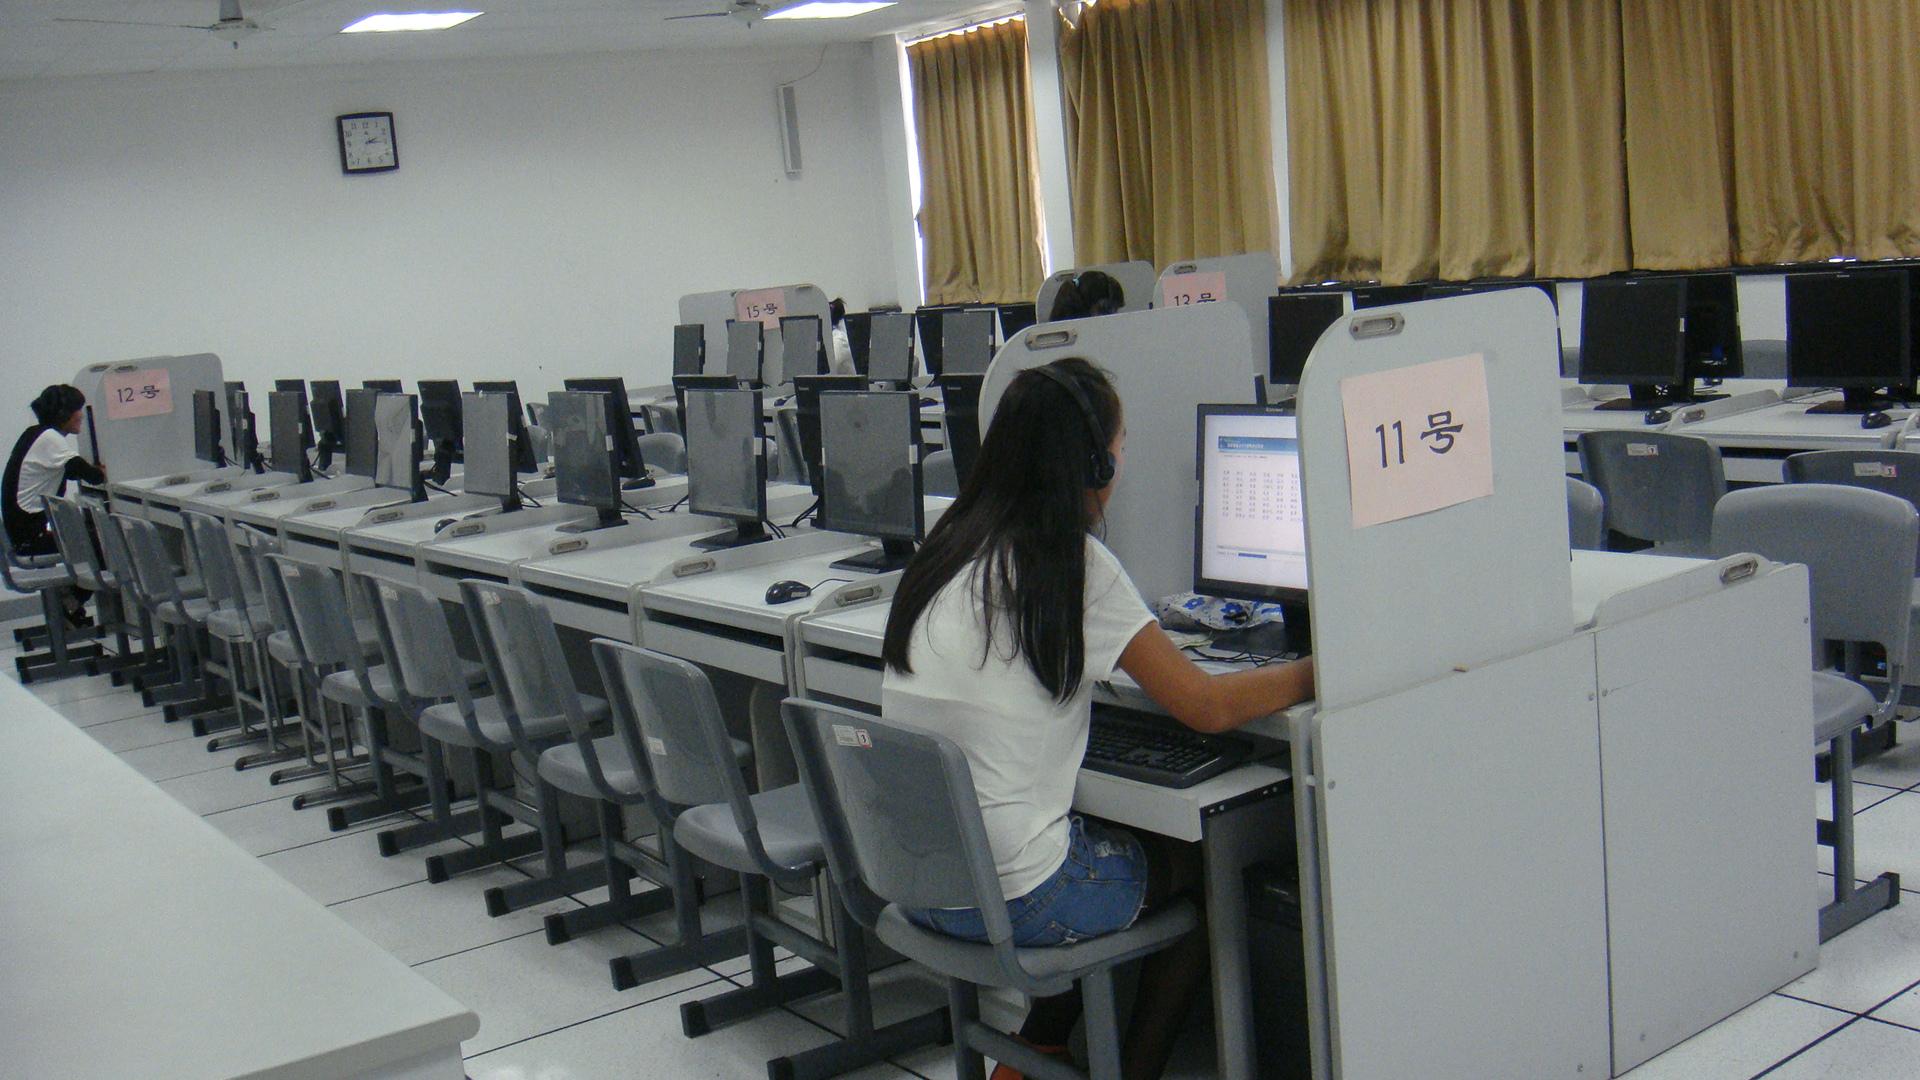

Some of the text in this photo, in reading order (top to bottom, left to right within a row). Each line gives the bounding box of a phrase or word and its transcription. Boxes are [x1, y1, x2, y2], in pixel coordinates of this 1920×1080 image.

[746, 303, 778, 319] 15 号
[117, 385, 160, 403] 12 号
[1375, 410, 1464, 468] 11 号
